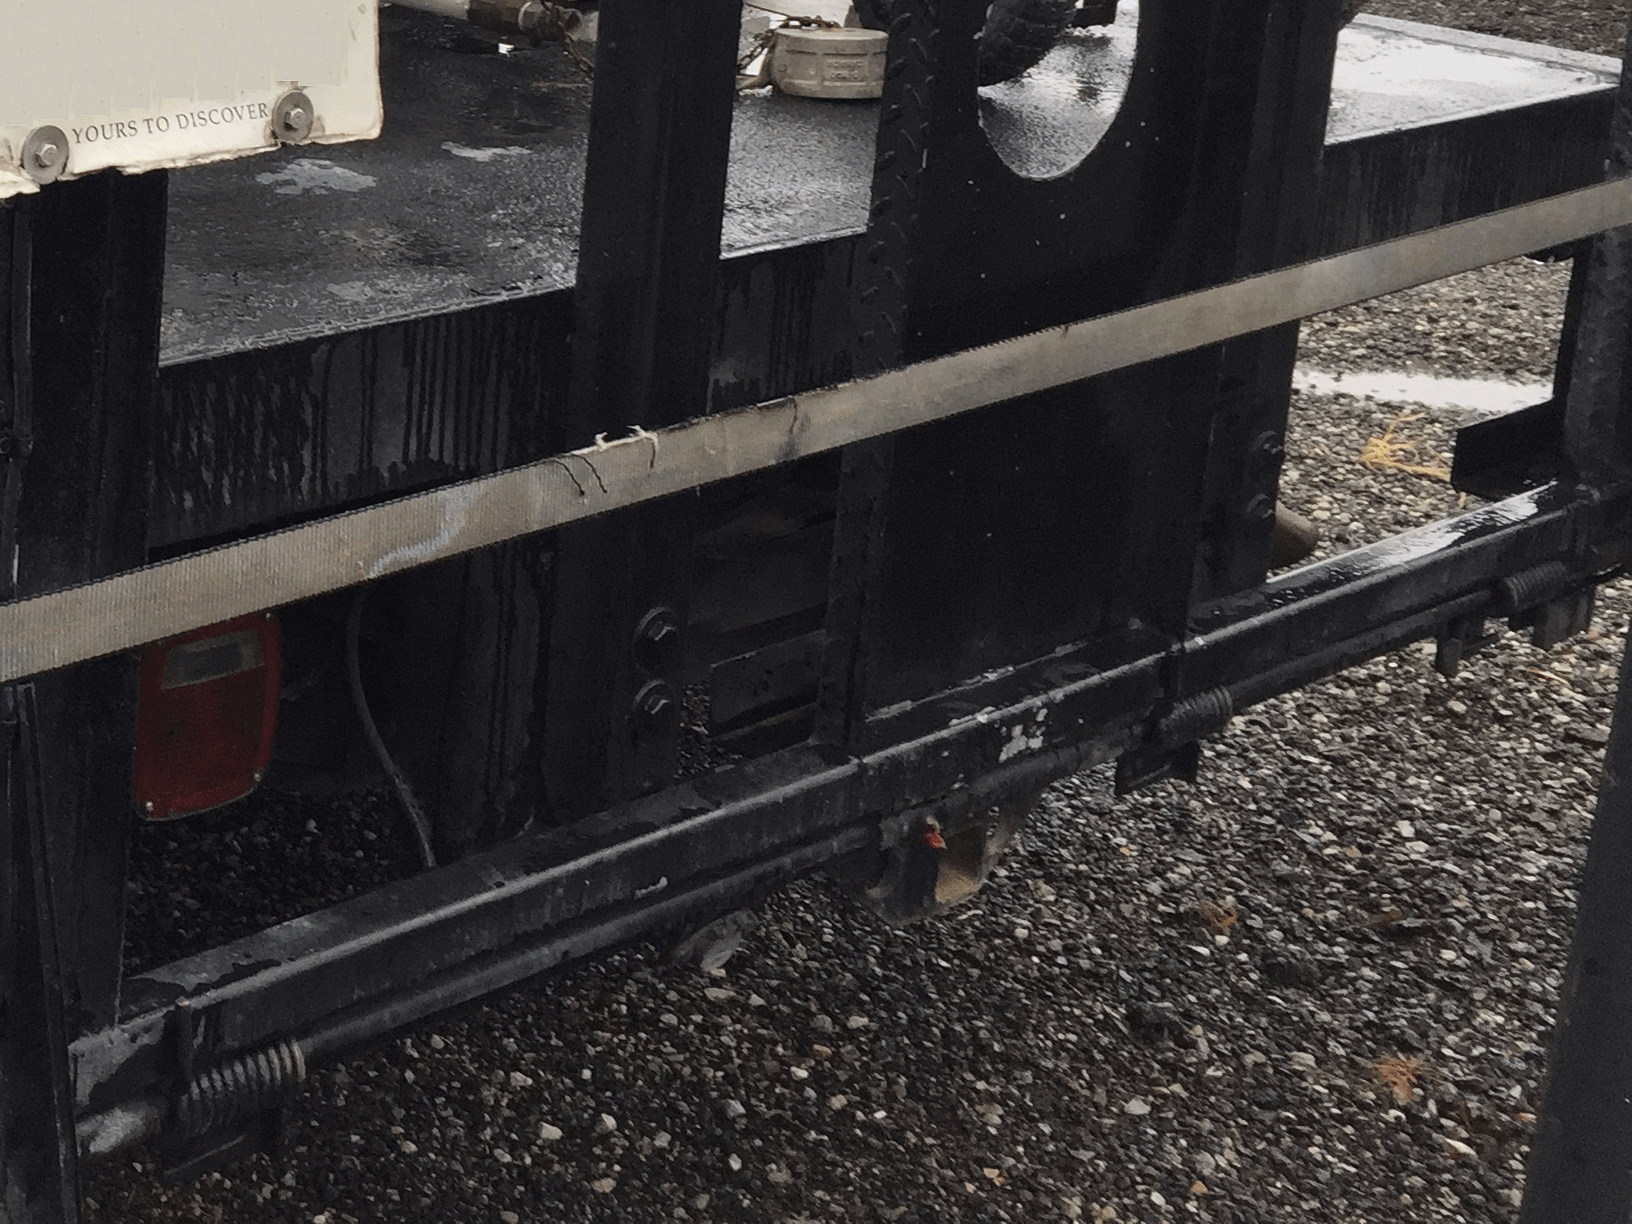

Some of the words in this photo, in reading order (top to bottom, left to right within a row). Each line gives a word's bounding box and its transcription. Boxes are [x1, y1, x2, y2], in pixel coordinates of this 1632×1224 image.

[72, 122, 138, 144] YOURS
[144, 116, 170, 134] TO
[176, 102, 269, 130] DISCOVER
